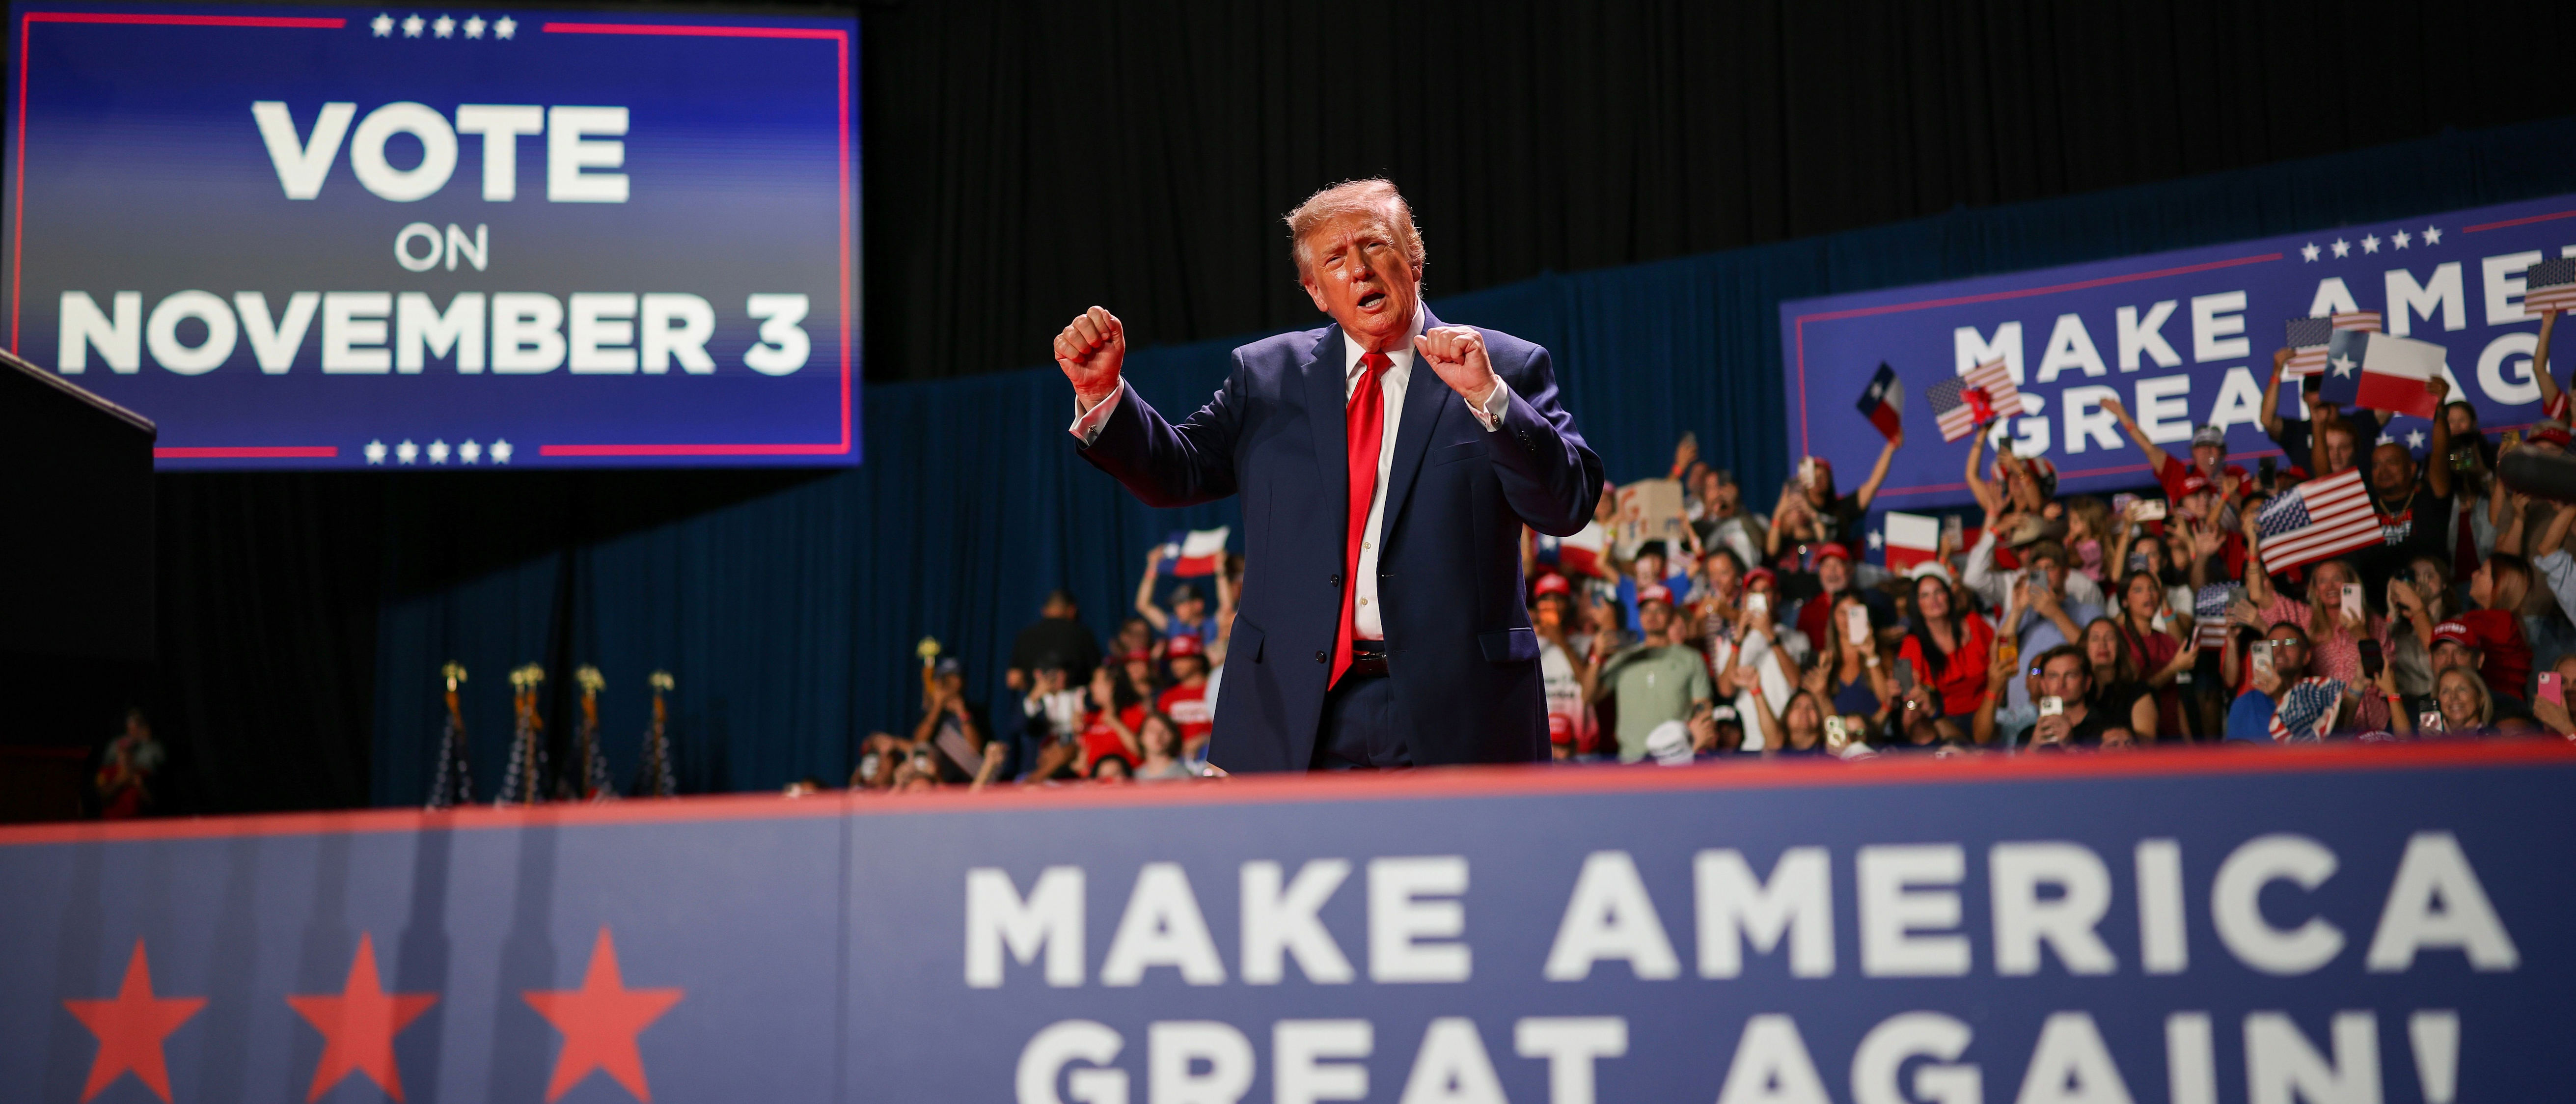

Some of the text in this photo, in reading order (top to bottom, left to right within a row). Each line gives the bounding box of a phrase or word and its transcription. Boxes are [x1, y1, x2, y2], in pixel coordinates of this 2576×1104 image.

[252, 101, 630, 203] VOTE
[394, 222, 489, 272] ON
[58, 290, 811, 376] NOVEMBER 3
[1953, 244, 2576, 386] MAKE AME
[2434, 622, 2466, 635] TRUMP
[963, 834, 2518, 989] MAKE AMERICA
[1014, 1012, 2457, 1104] GREAT AGAIN!
